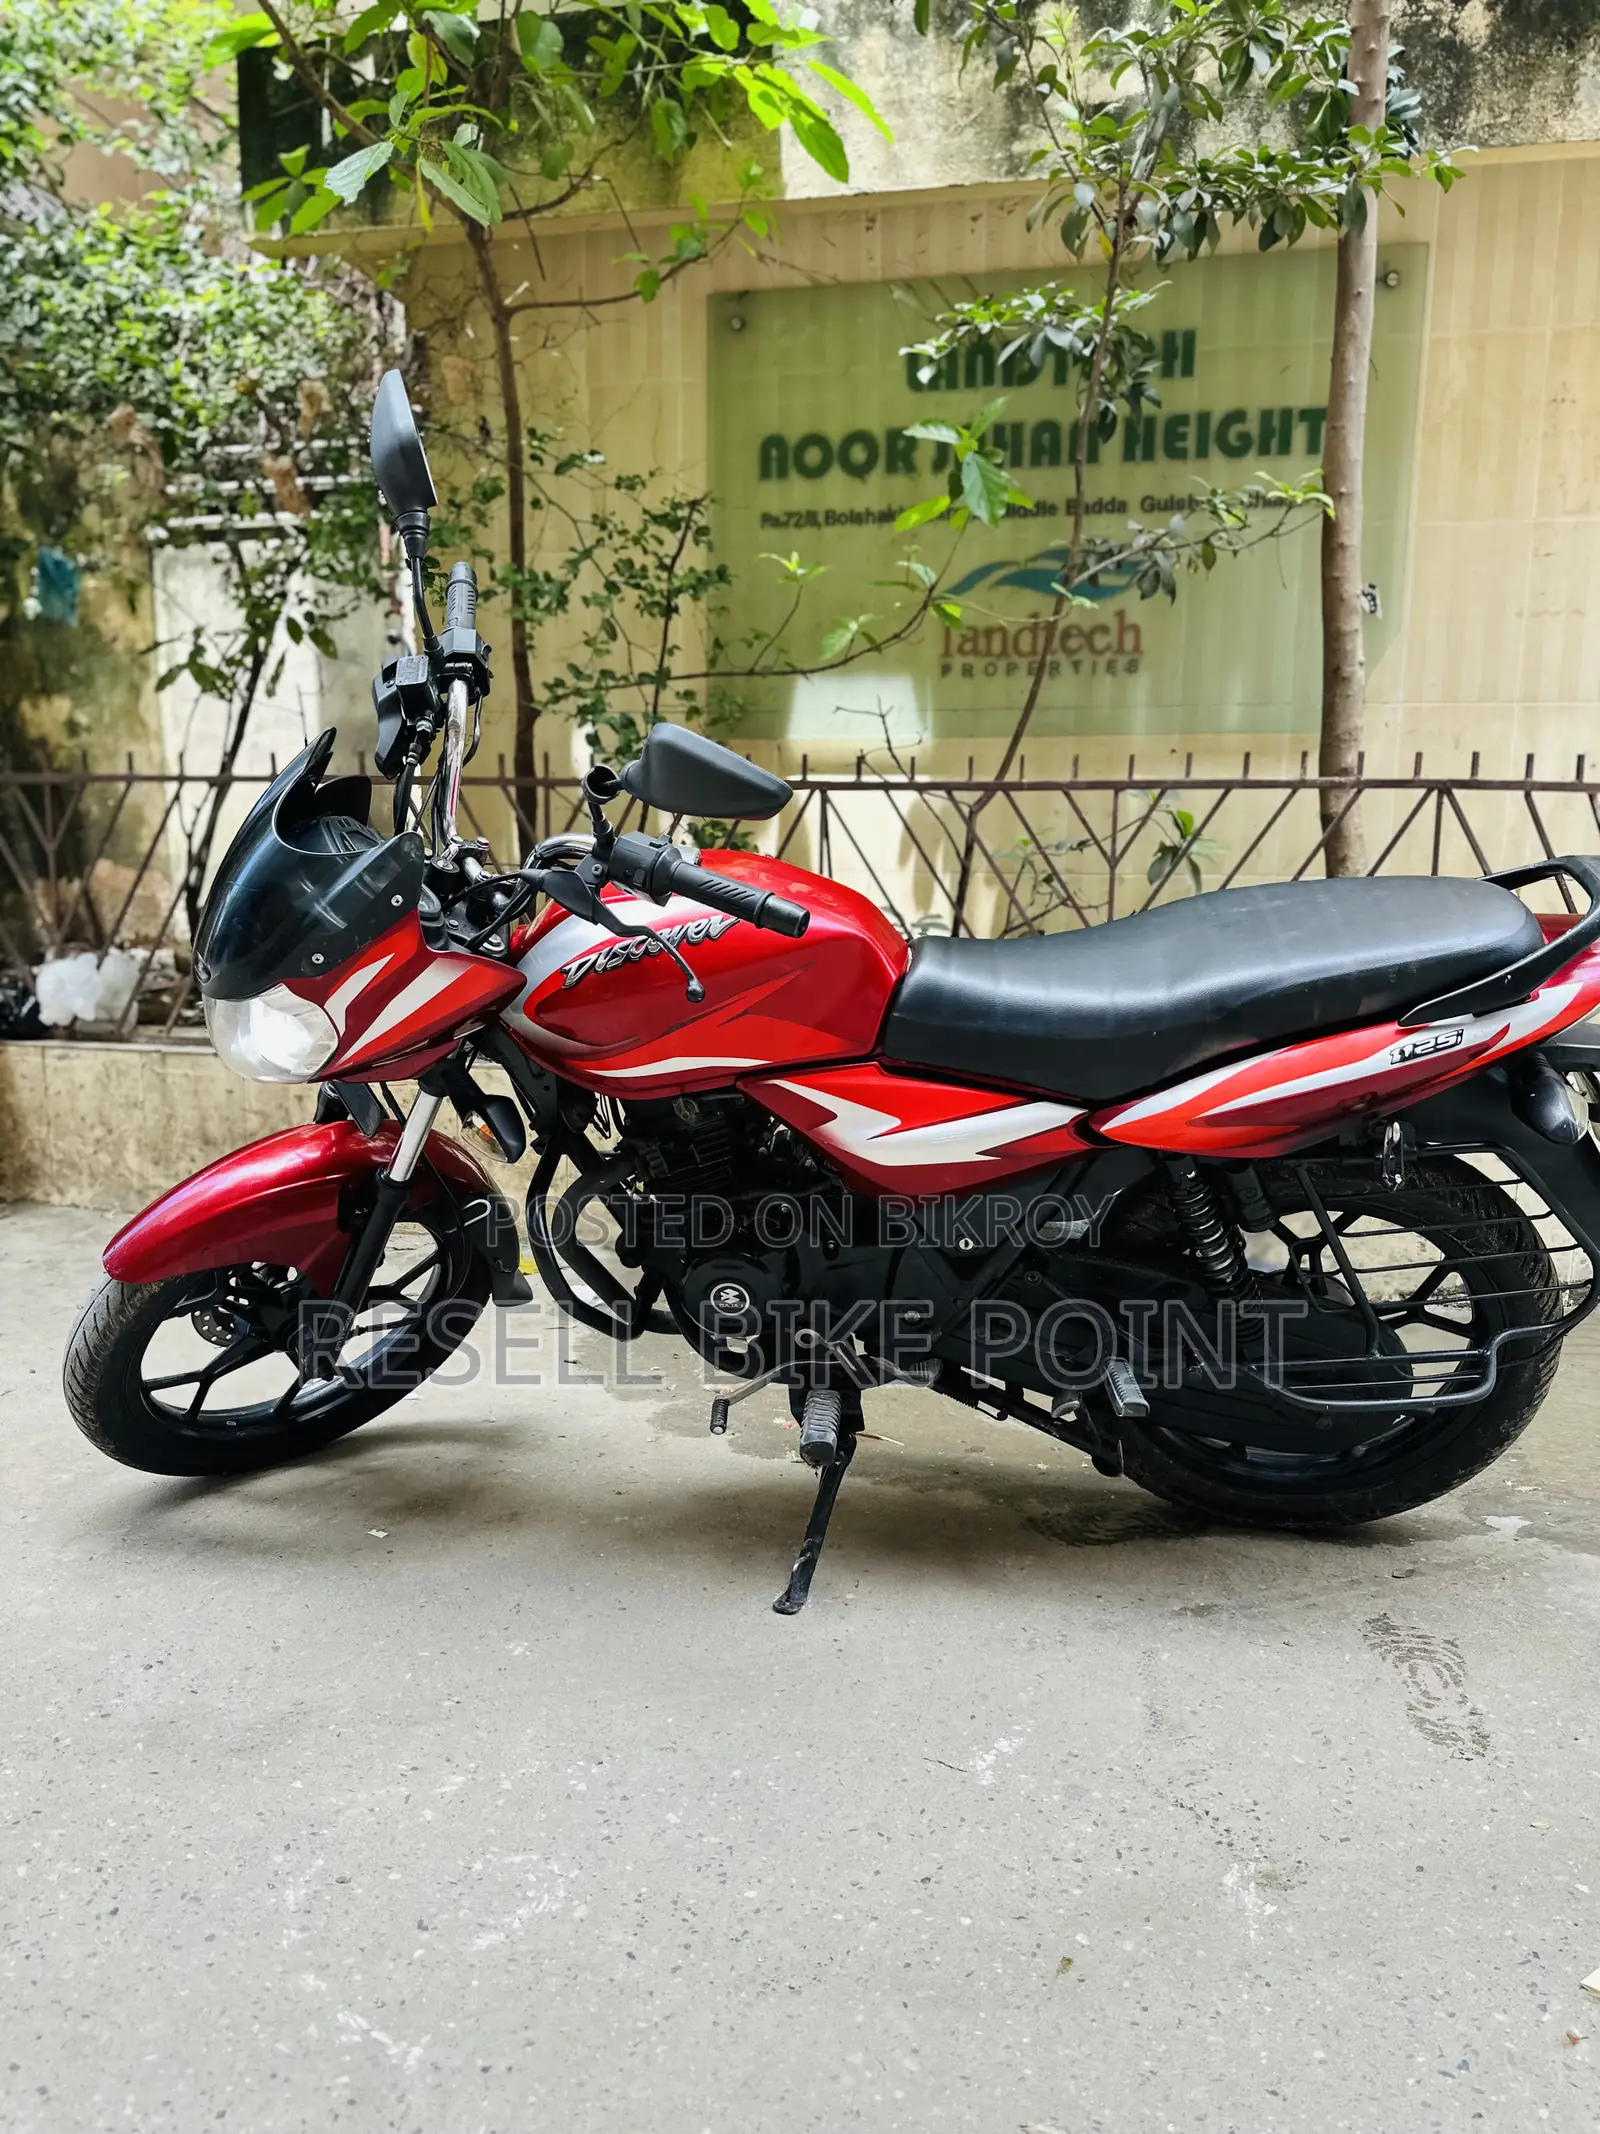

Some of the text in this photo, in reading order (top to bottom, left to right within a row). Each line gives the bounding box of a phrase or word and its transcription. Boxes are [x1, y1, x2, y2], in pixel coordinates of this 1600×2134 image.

[906, 328, 1196, 392] LANDTH
[930, 420, 1099, 475] JHAN
[1122, 406, 1328, 463] HEIGHT
[939, 606, 1144, 659] landech
[939, 657, 1141, 679] PROPERTIES
